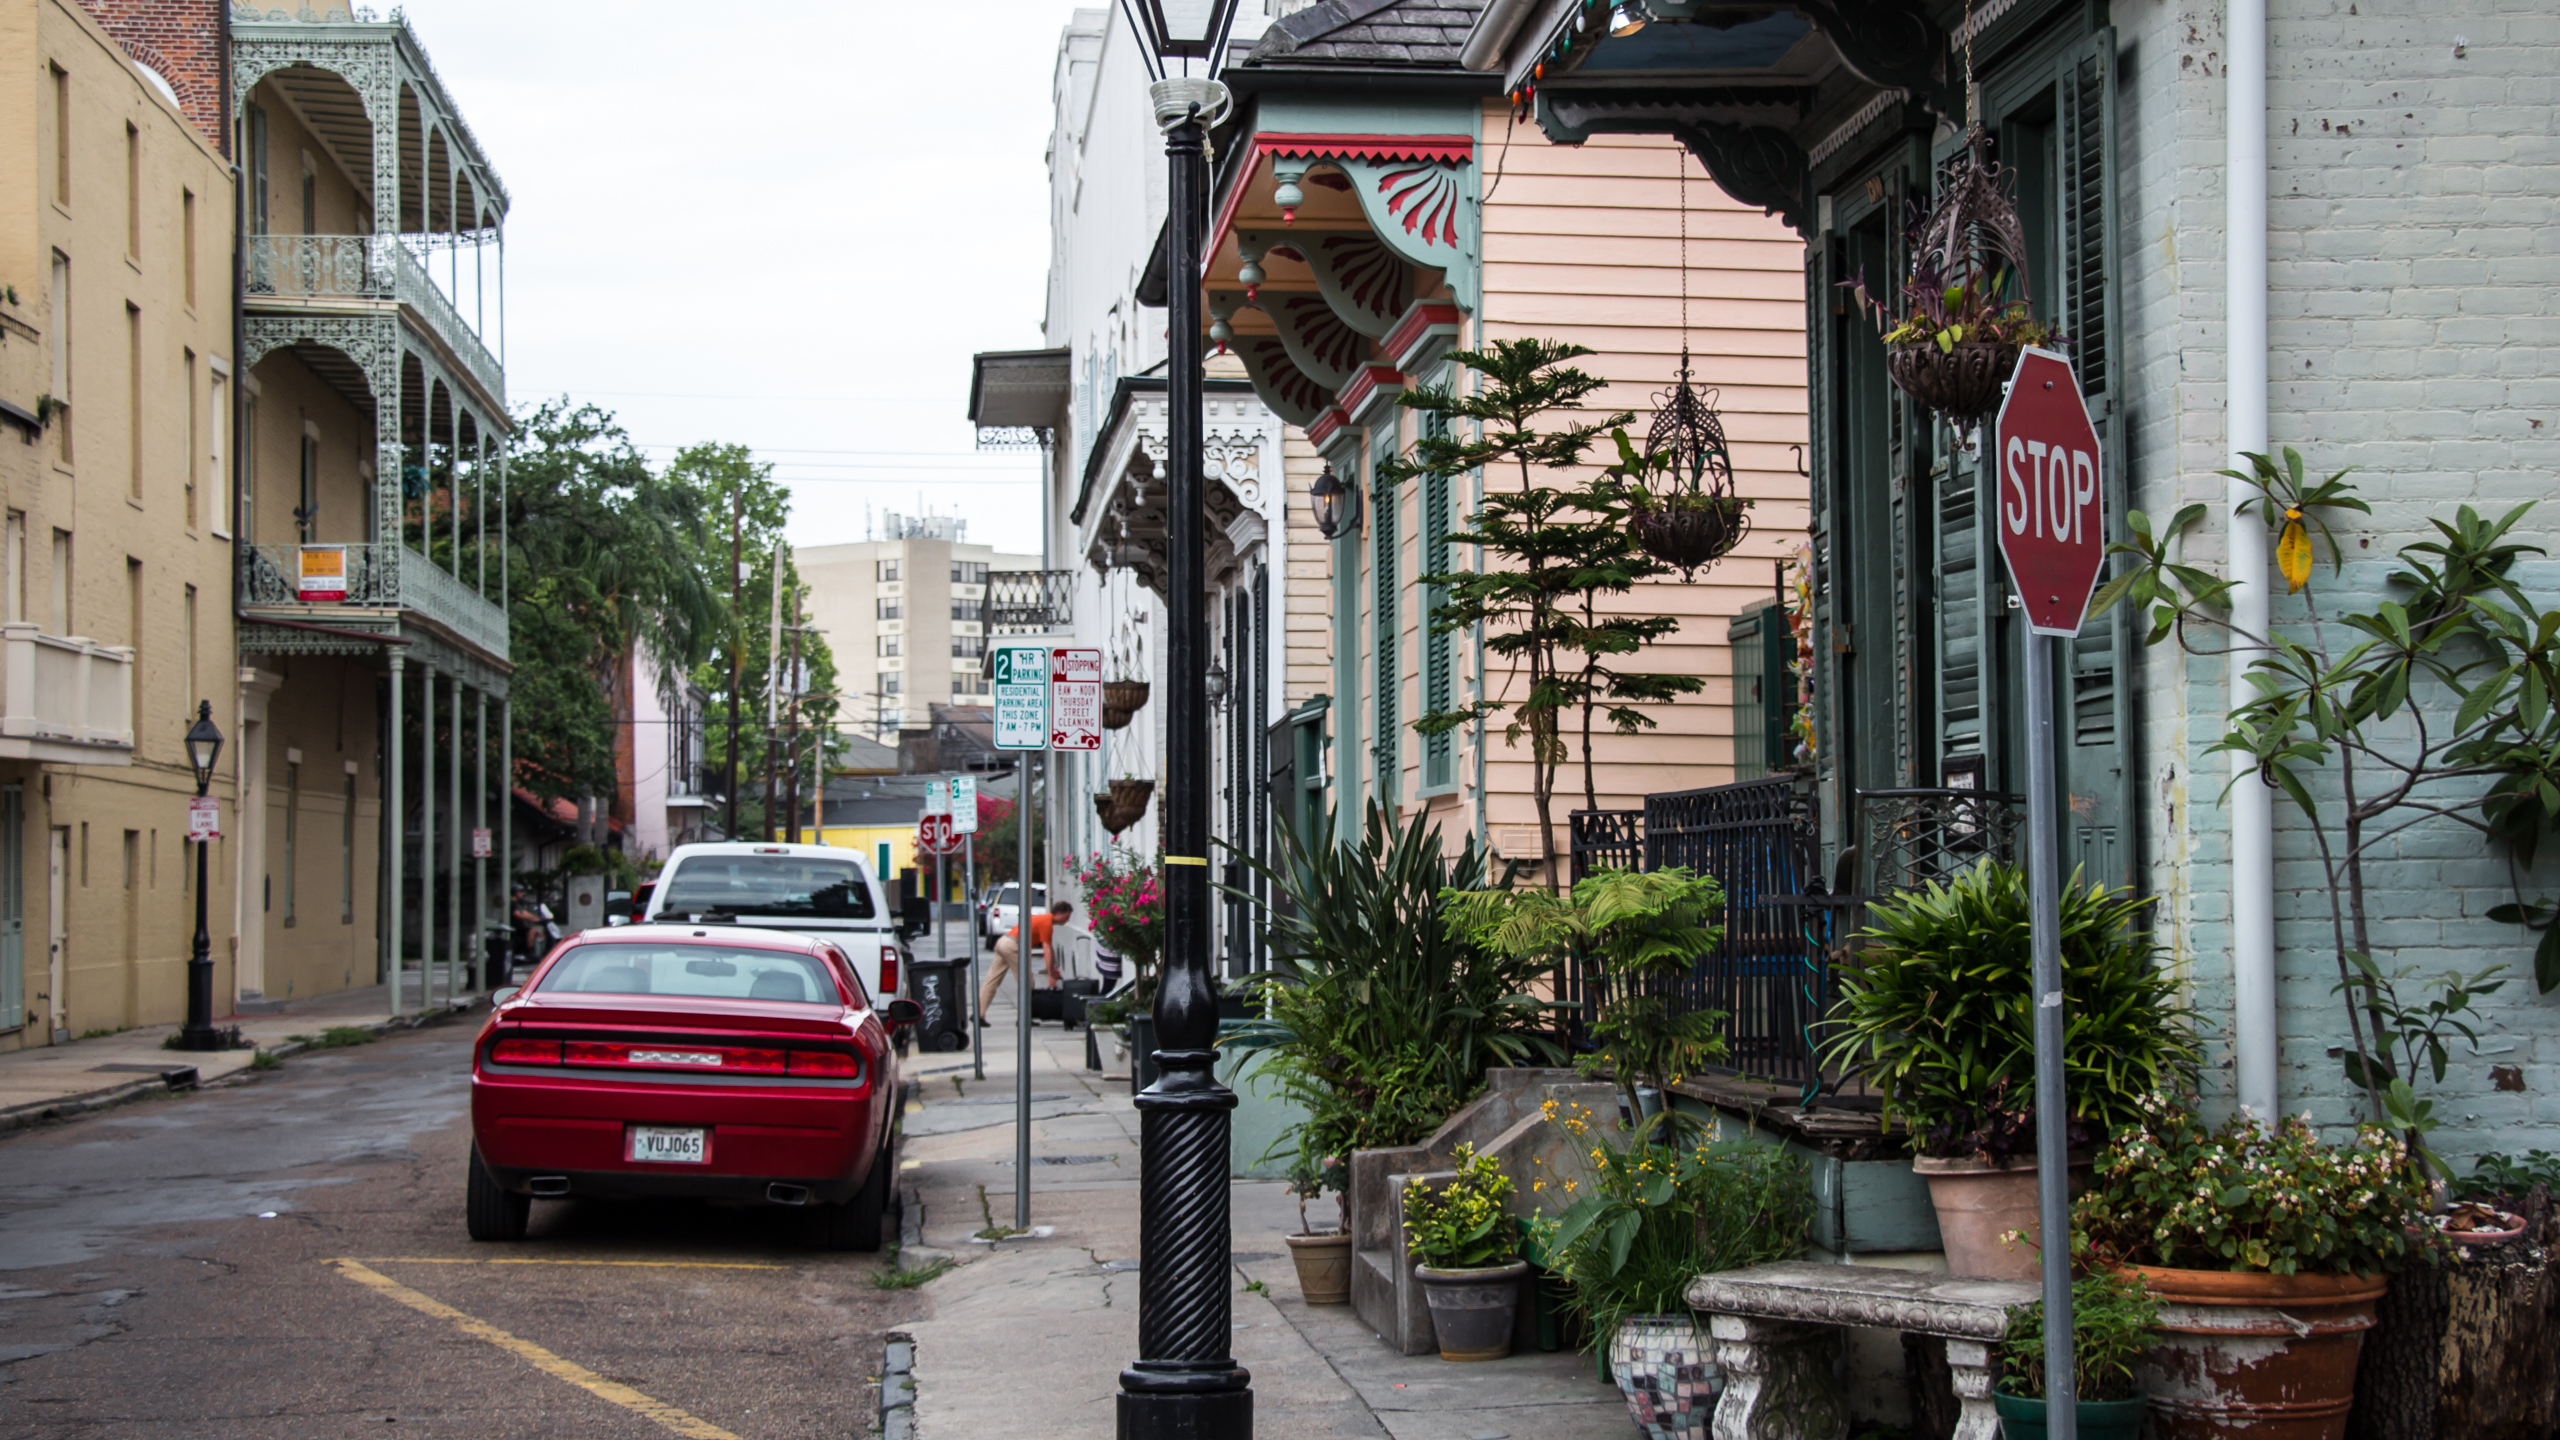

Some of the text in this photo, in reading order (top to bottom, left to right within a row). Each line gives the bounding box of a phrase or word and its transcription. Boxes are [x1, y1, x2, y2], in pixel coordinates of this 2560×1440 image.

[2006, 435, 2094, 545] STOP
[1021, 652, 1035, 665] HR
[997, 654, 1009, 680] 2
[1053, 656, 1099, 675] NO STOPPING
[1012, 668, 1044, 681] PARKING
[1001, 686, 1040, 697] RESIDENTIAL
[1079, 684, 1096, 696] NOON
[998, 698, 1043, 708] PARKING AREA
[1060, 697, 1094, 707] THURSDAY
[1001, 710, 1039, 721] THIS ZONE
[1063, 707, 1090, 718] STREET
[999, 722, 1004, 732] 7
[1006, 722, 1017, 732] AM
[1023, 722, 1028, 732] 7
[1030, 722, 1042, 732] PM
[1058, 717, 1095, 728] CLEANING
[953, 782, 960, 797] 2
[922, 822, 955, 840] STO
[647, 1136, 700, 1154] VUJ065
